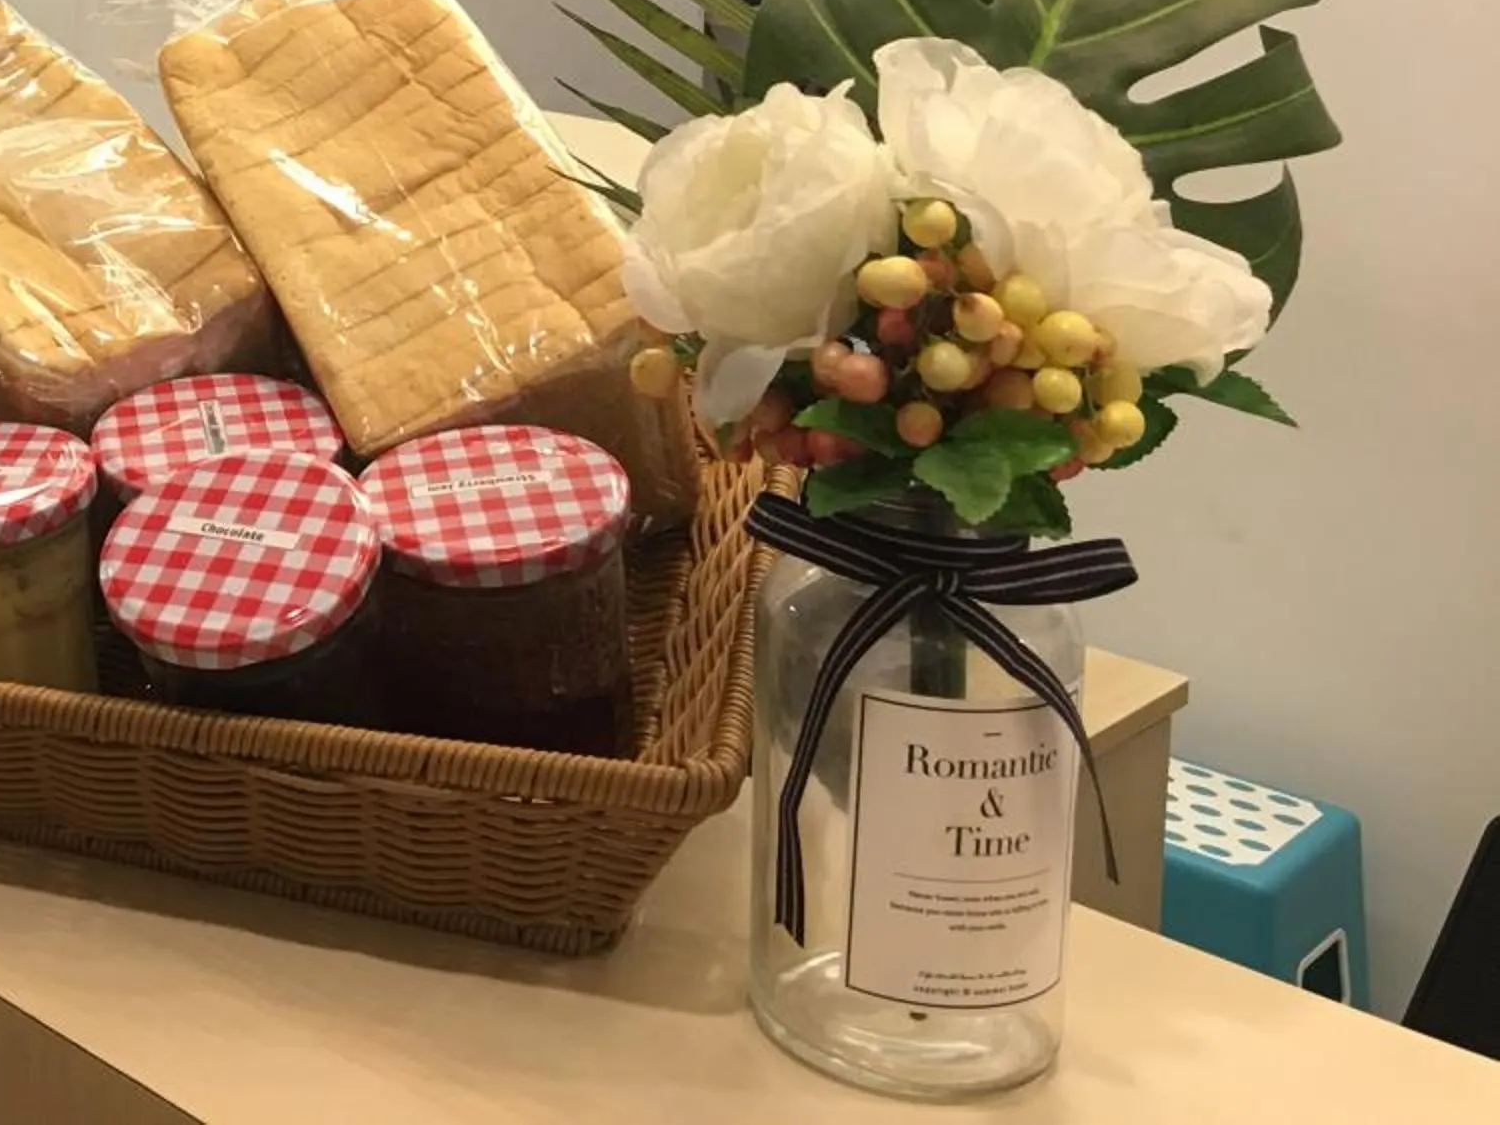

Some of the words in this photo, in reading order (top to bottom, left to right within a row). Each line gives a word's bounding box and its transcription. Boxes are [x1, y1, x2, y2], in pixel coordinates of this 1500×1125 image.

[201, 522, 265, 541] Chocolate
[905, 742, 1058, 780] Romantic
[979, 787, 1005, 818] &
[946, 825, 1031, 857] Time
